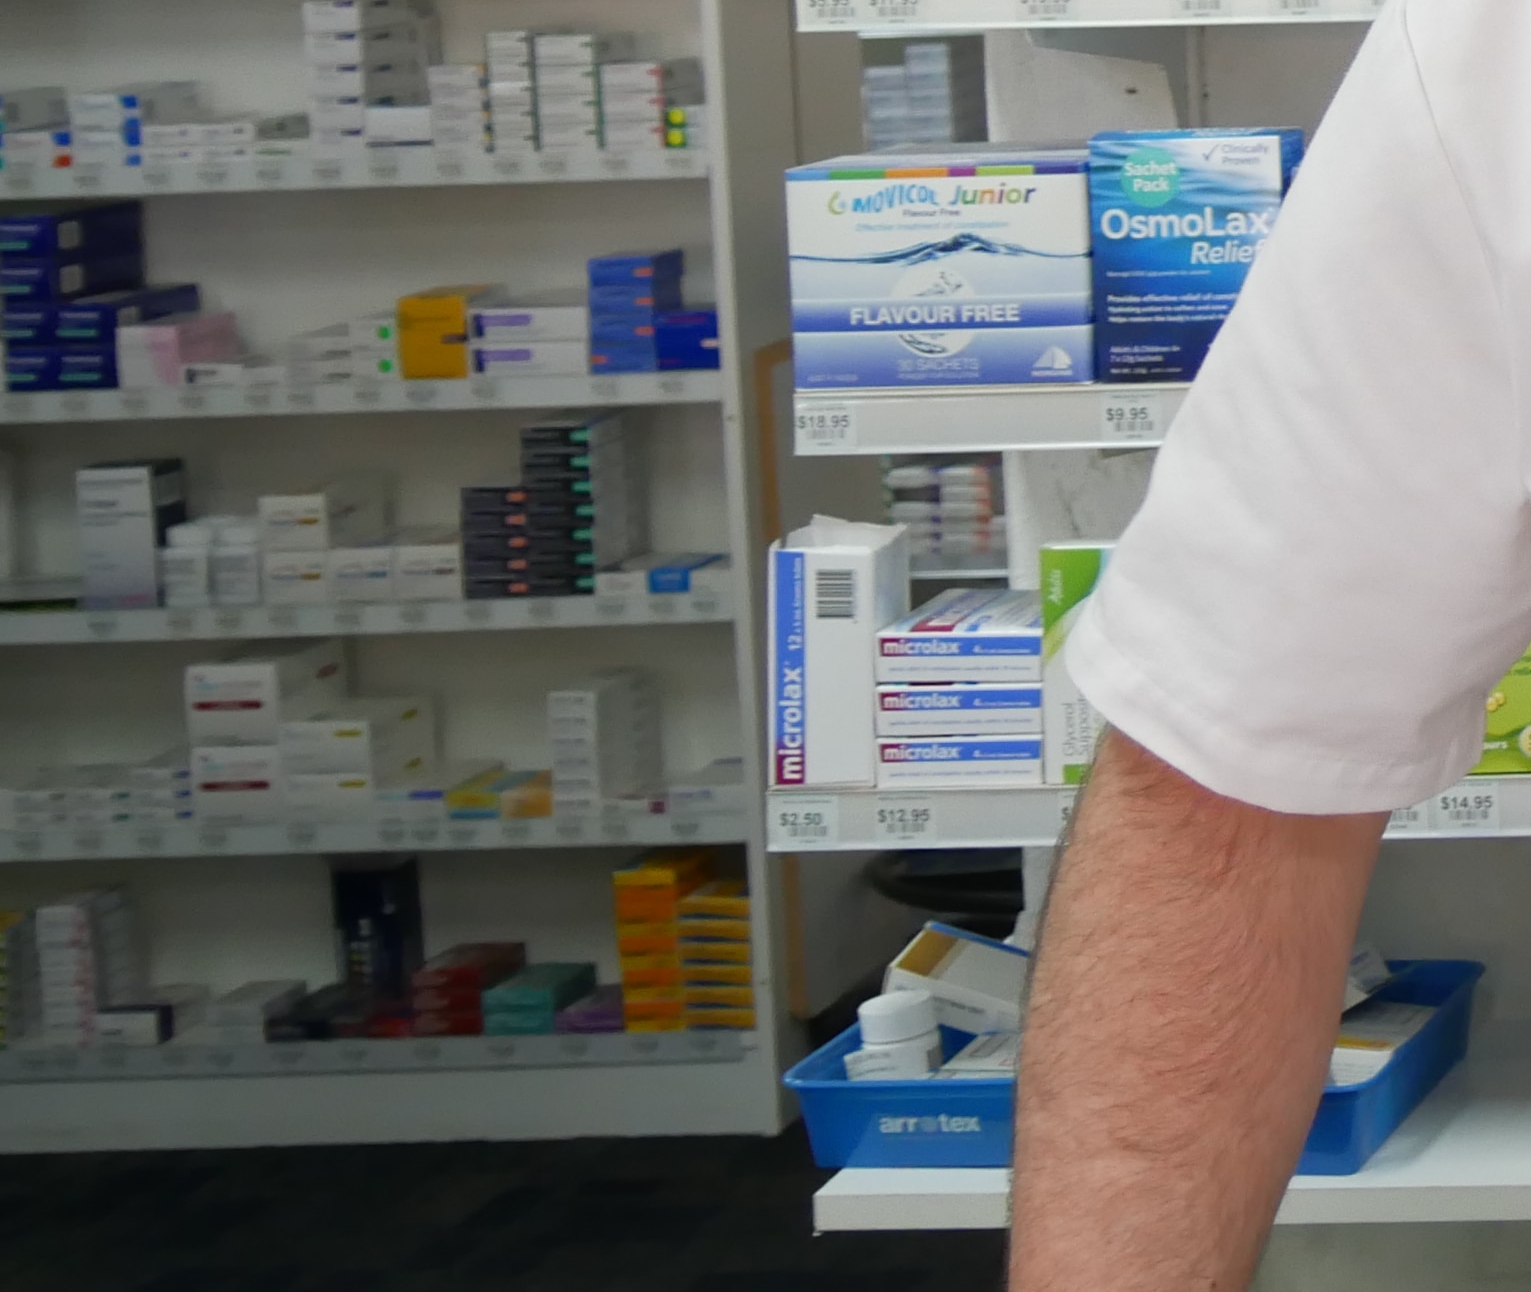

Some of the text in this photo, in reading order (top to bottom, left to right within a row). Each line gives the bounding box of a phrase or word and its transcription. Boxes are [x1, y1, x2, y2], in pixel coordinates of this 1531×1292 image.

[1221, 143, 1269, 155] Clinically
[1124, 161, 1177, 177] Sachet
[1133, 178, 1170, 192] Pack
[853, 181, 1037, 213] MOVICOL Junior
[939, 207, 961, 217] Free
[1101, 207, 1270, 240] OsmoLax
[850, 303, 1021, 327] FLAVOUR FREE
[917, 358, 981, 370] SACHETS
[797, 414, 850, 429] $18.95
[1106, 407, 1149, 422] $9.95
[787, 634, 802, 651] 12
[883, 639, 960, 655] microlax
[883, 692, 961, 709] microlax
[778, 666, 802, 780] microlax
[1061, 702, 1074, 756] Glycerol
[883, 744, 961, 761] microlax
[1440, 795, 1494, 810] $14.95
[779, 812, 822, 826] $2.50
[878, 808, 930, 825] $12.95
